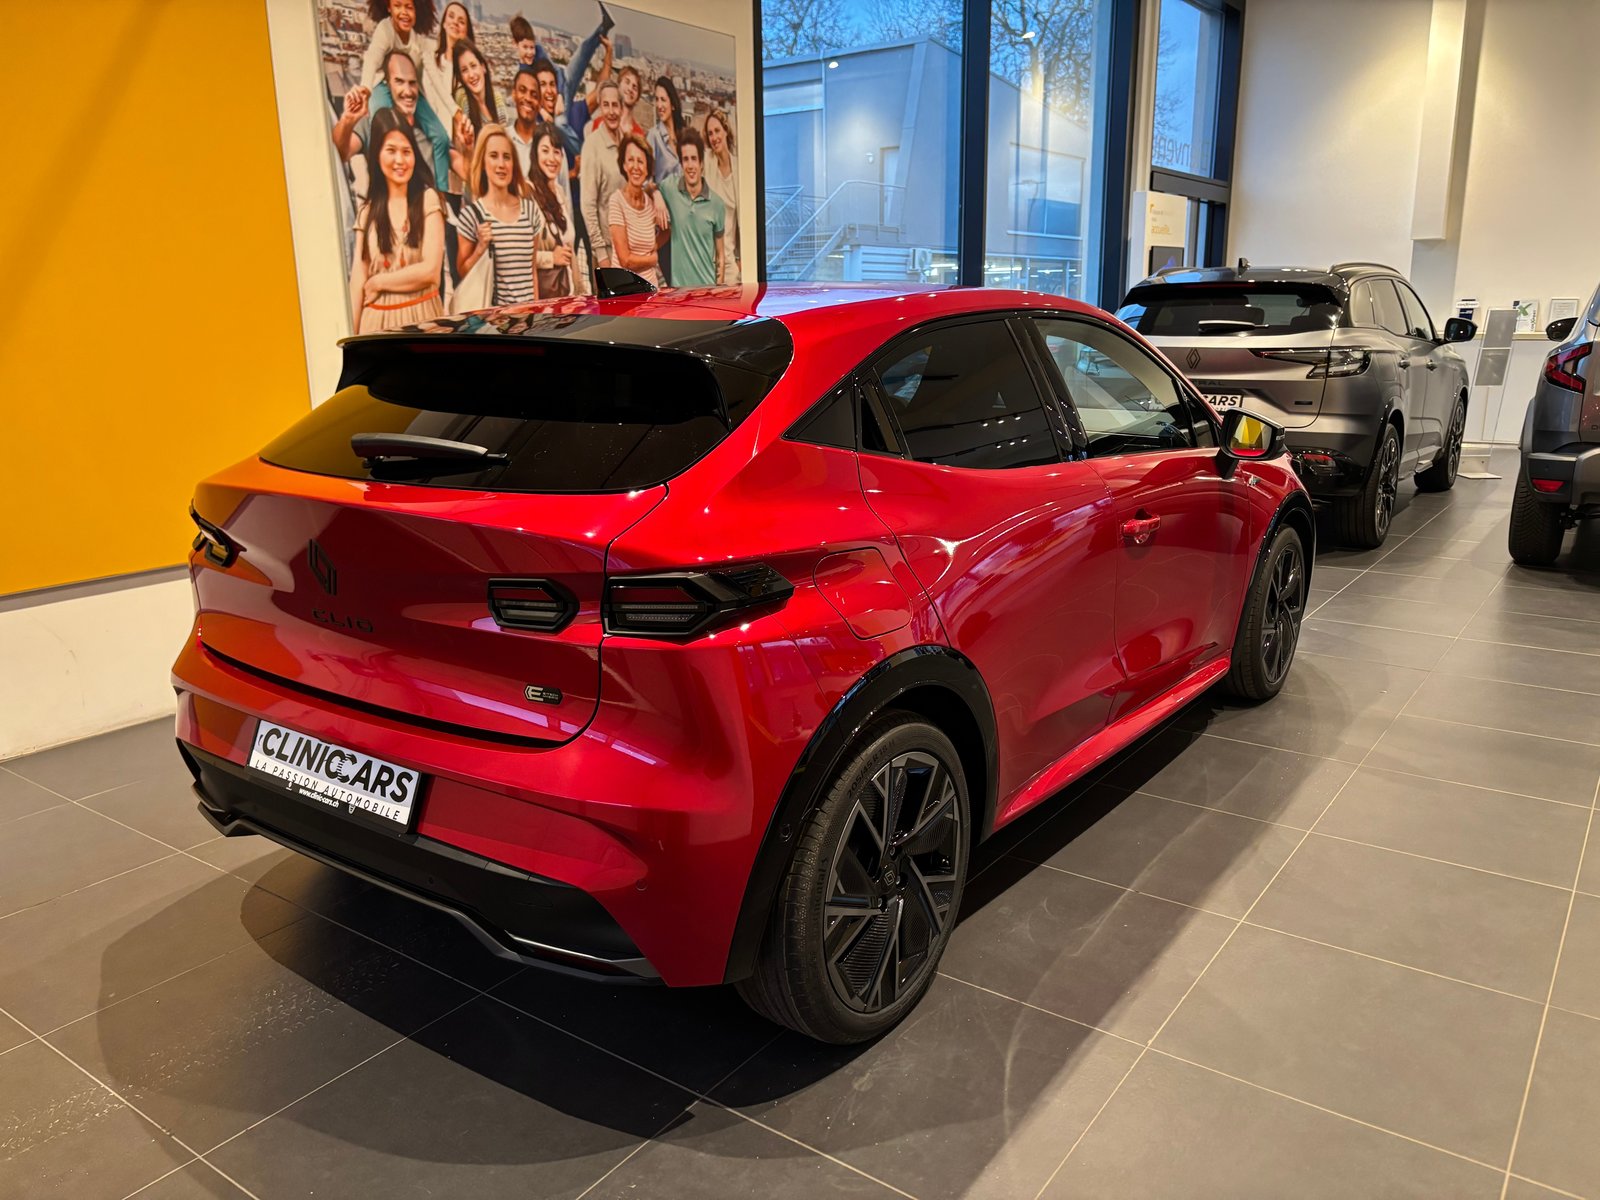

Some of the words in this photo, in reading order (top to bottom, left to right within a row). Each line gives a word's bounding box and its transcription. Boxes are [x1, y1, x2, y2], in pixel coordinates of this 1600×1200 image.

[312, 608, 374, 633] CLIO
[254, 759, 267, 771] LA
[273, 765, 319, 790] PASSION
[323, 784, 401, 821] AUTOMOBILE
